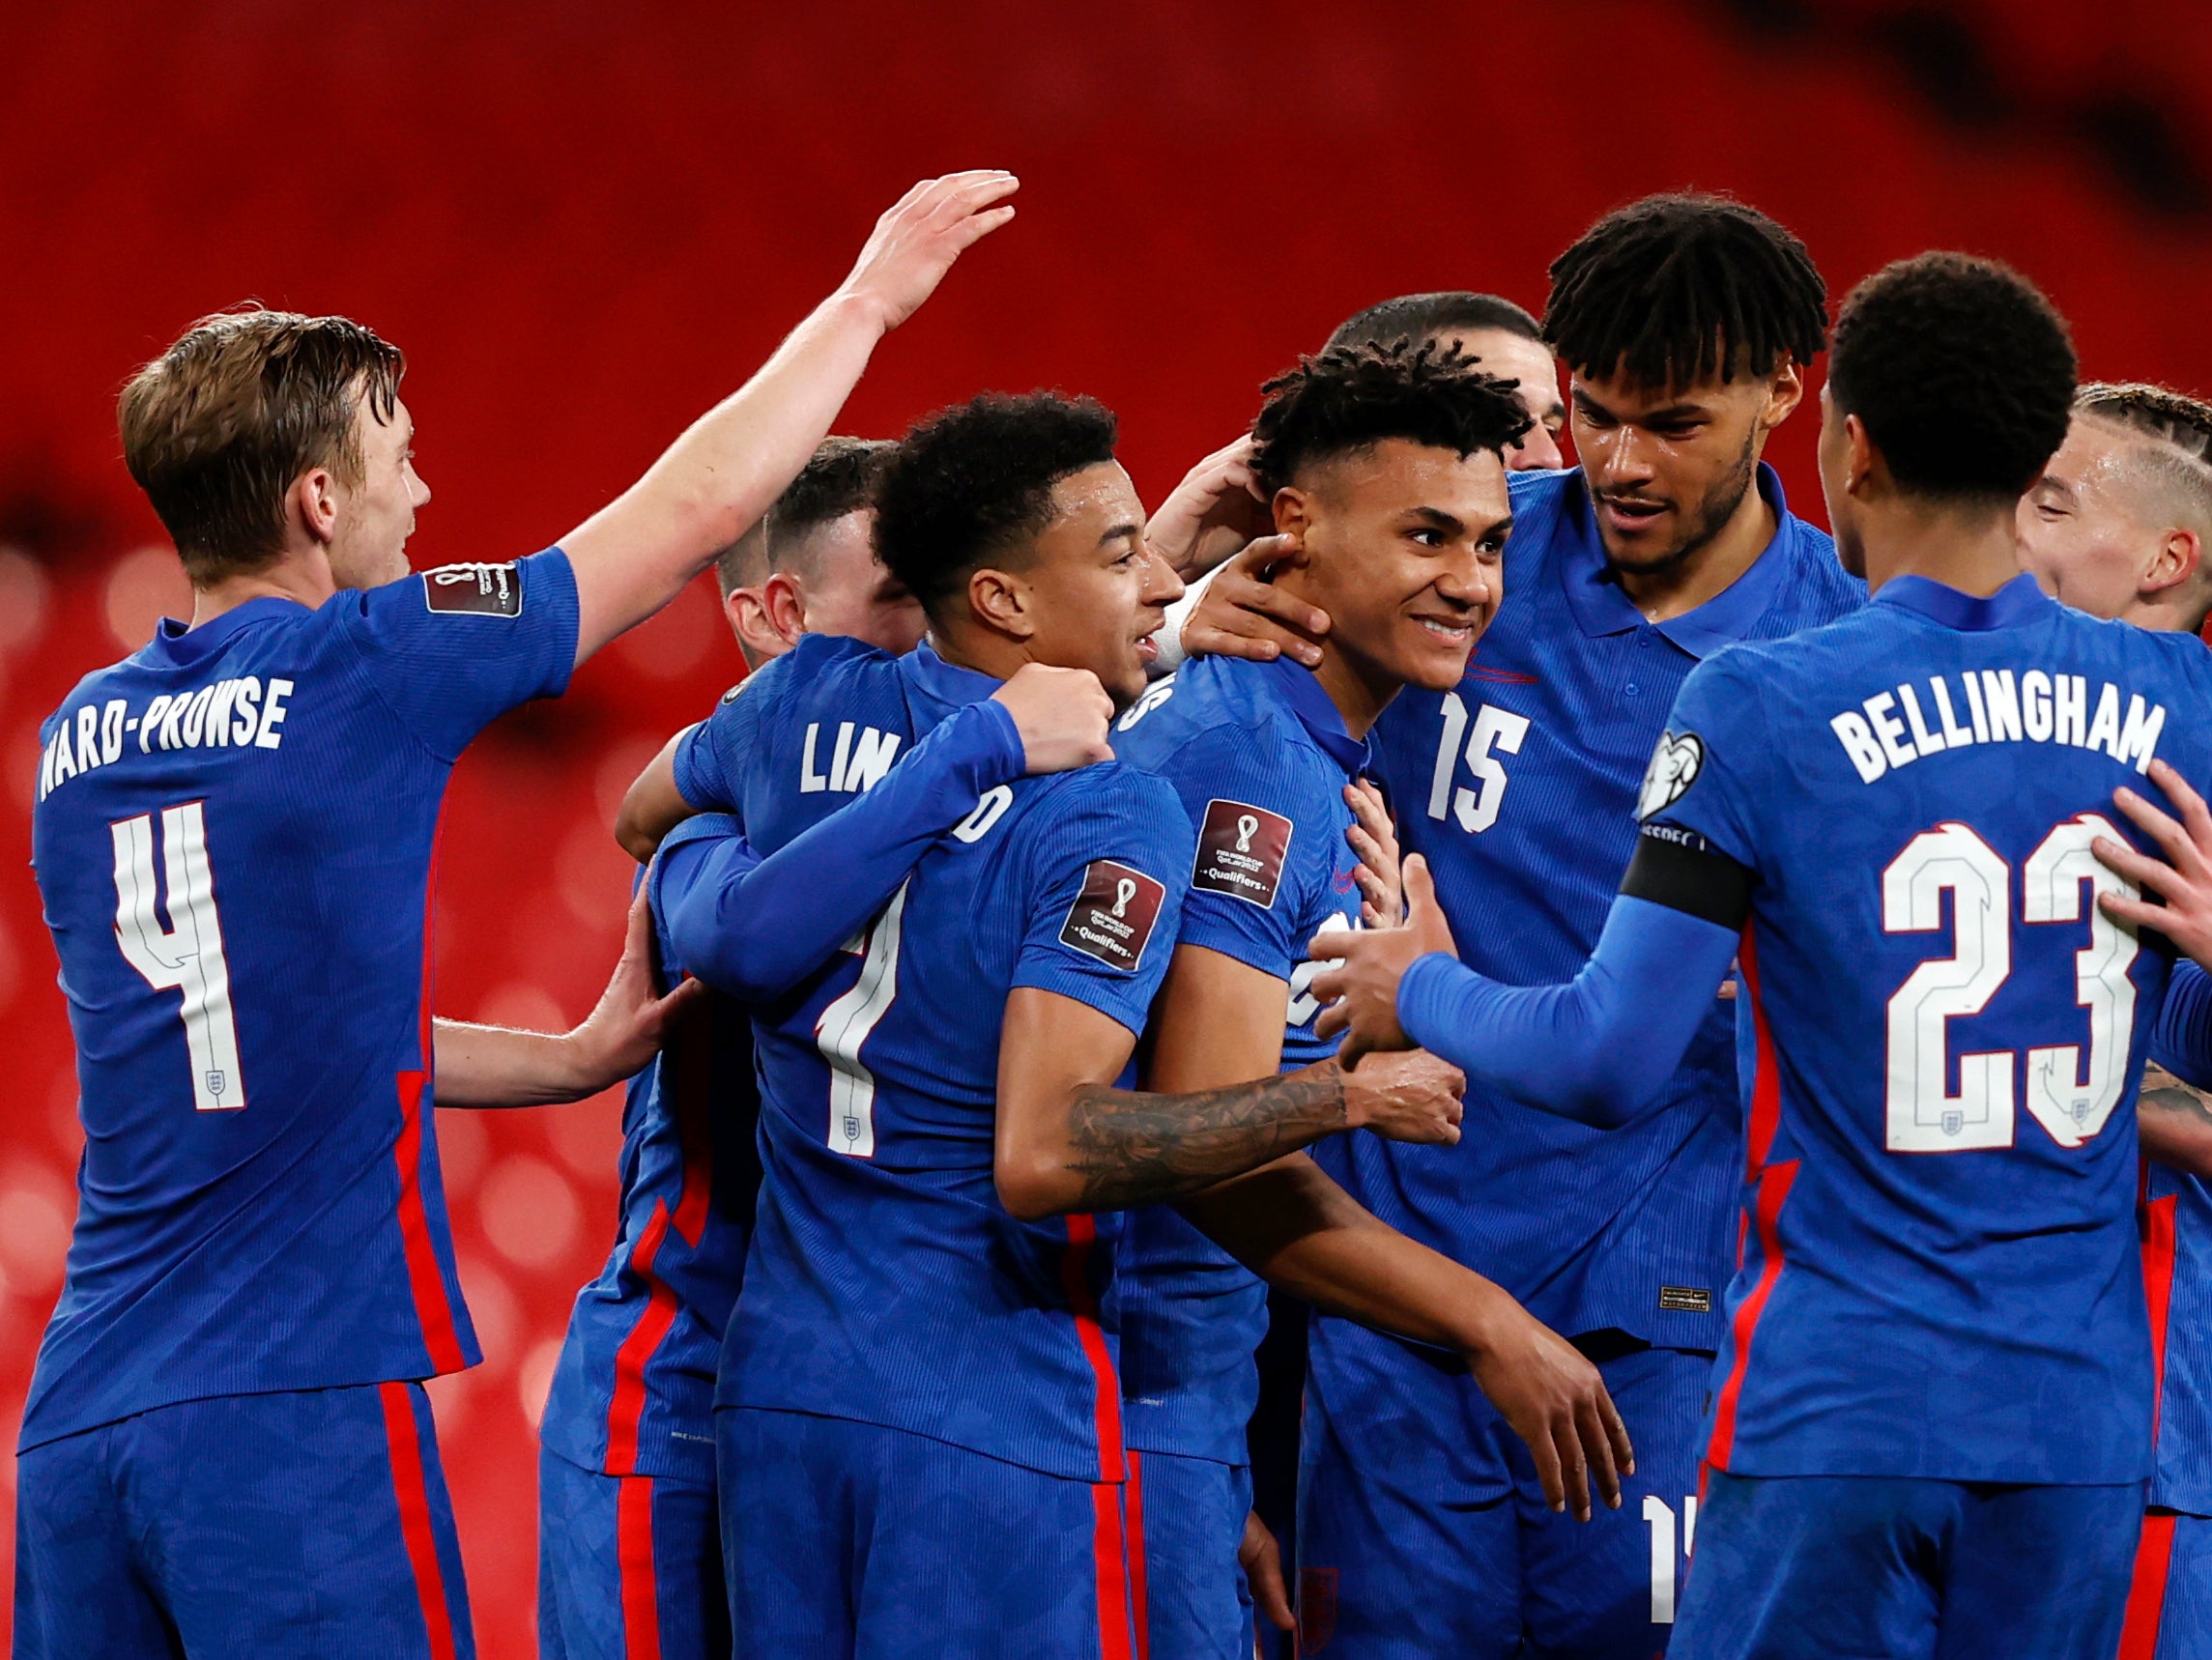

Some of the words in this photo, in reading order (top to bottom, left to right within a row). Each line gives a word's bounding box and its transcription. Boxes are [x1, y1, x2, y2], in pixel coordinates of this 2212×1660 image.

[800, 721, 1013, 844] LIND
[1427, 691, 1531, 833] 15
[1830, 669, 2167, 785] BELLINGHAM
[1079, 926, 1128, 957] Qualifiers
[1208, 868, 1262, 890] Qualifiers
[110, 800, 246, 1112] 4
[1882, 812, 2140, 1152] 23
[1643, 1495, 1698, 1623] 1
